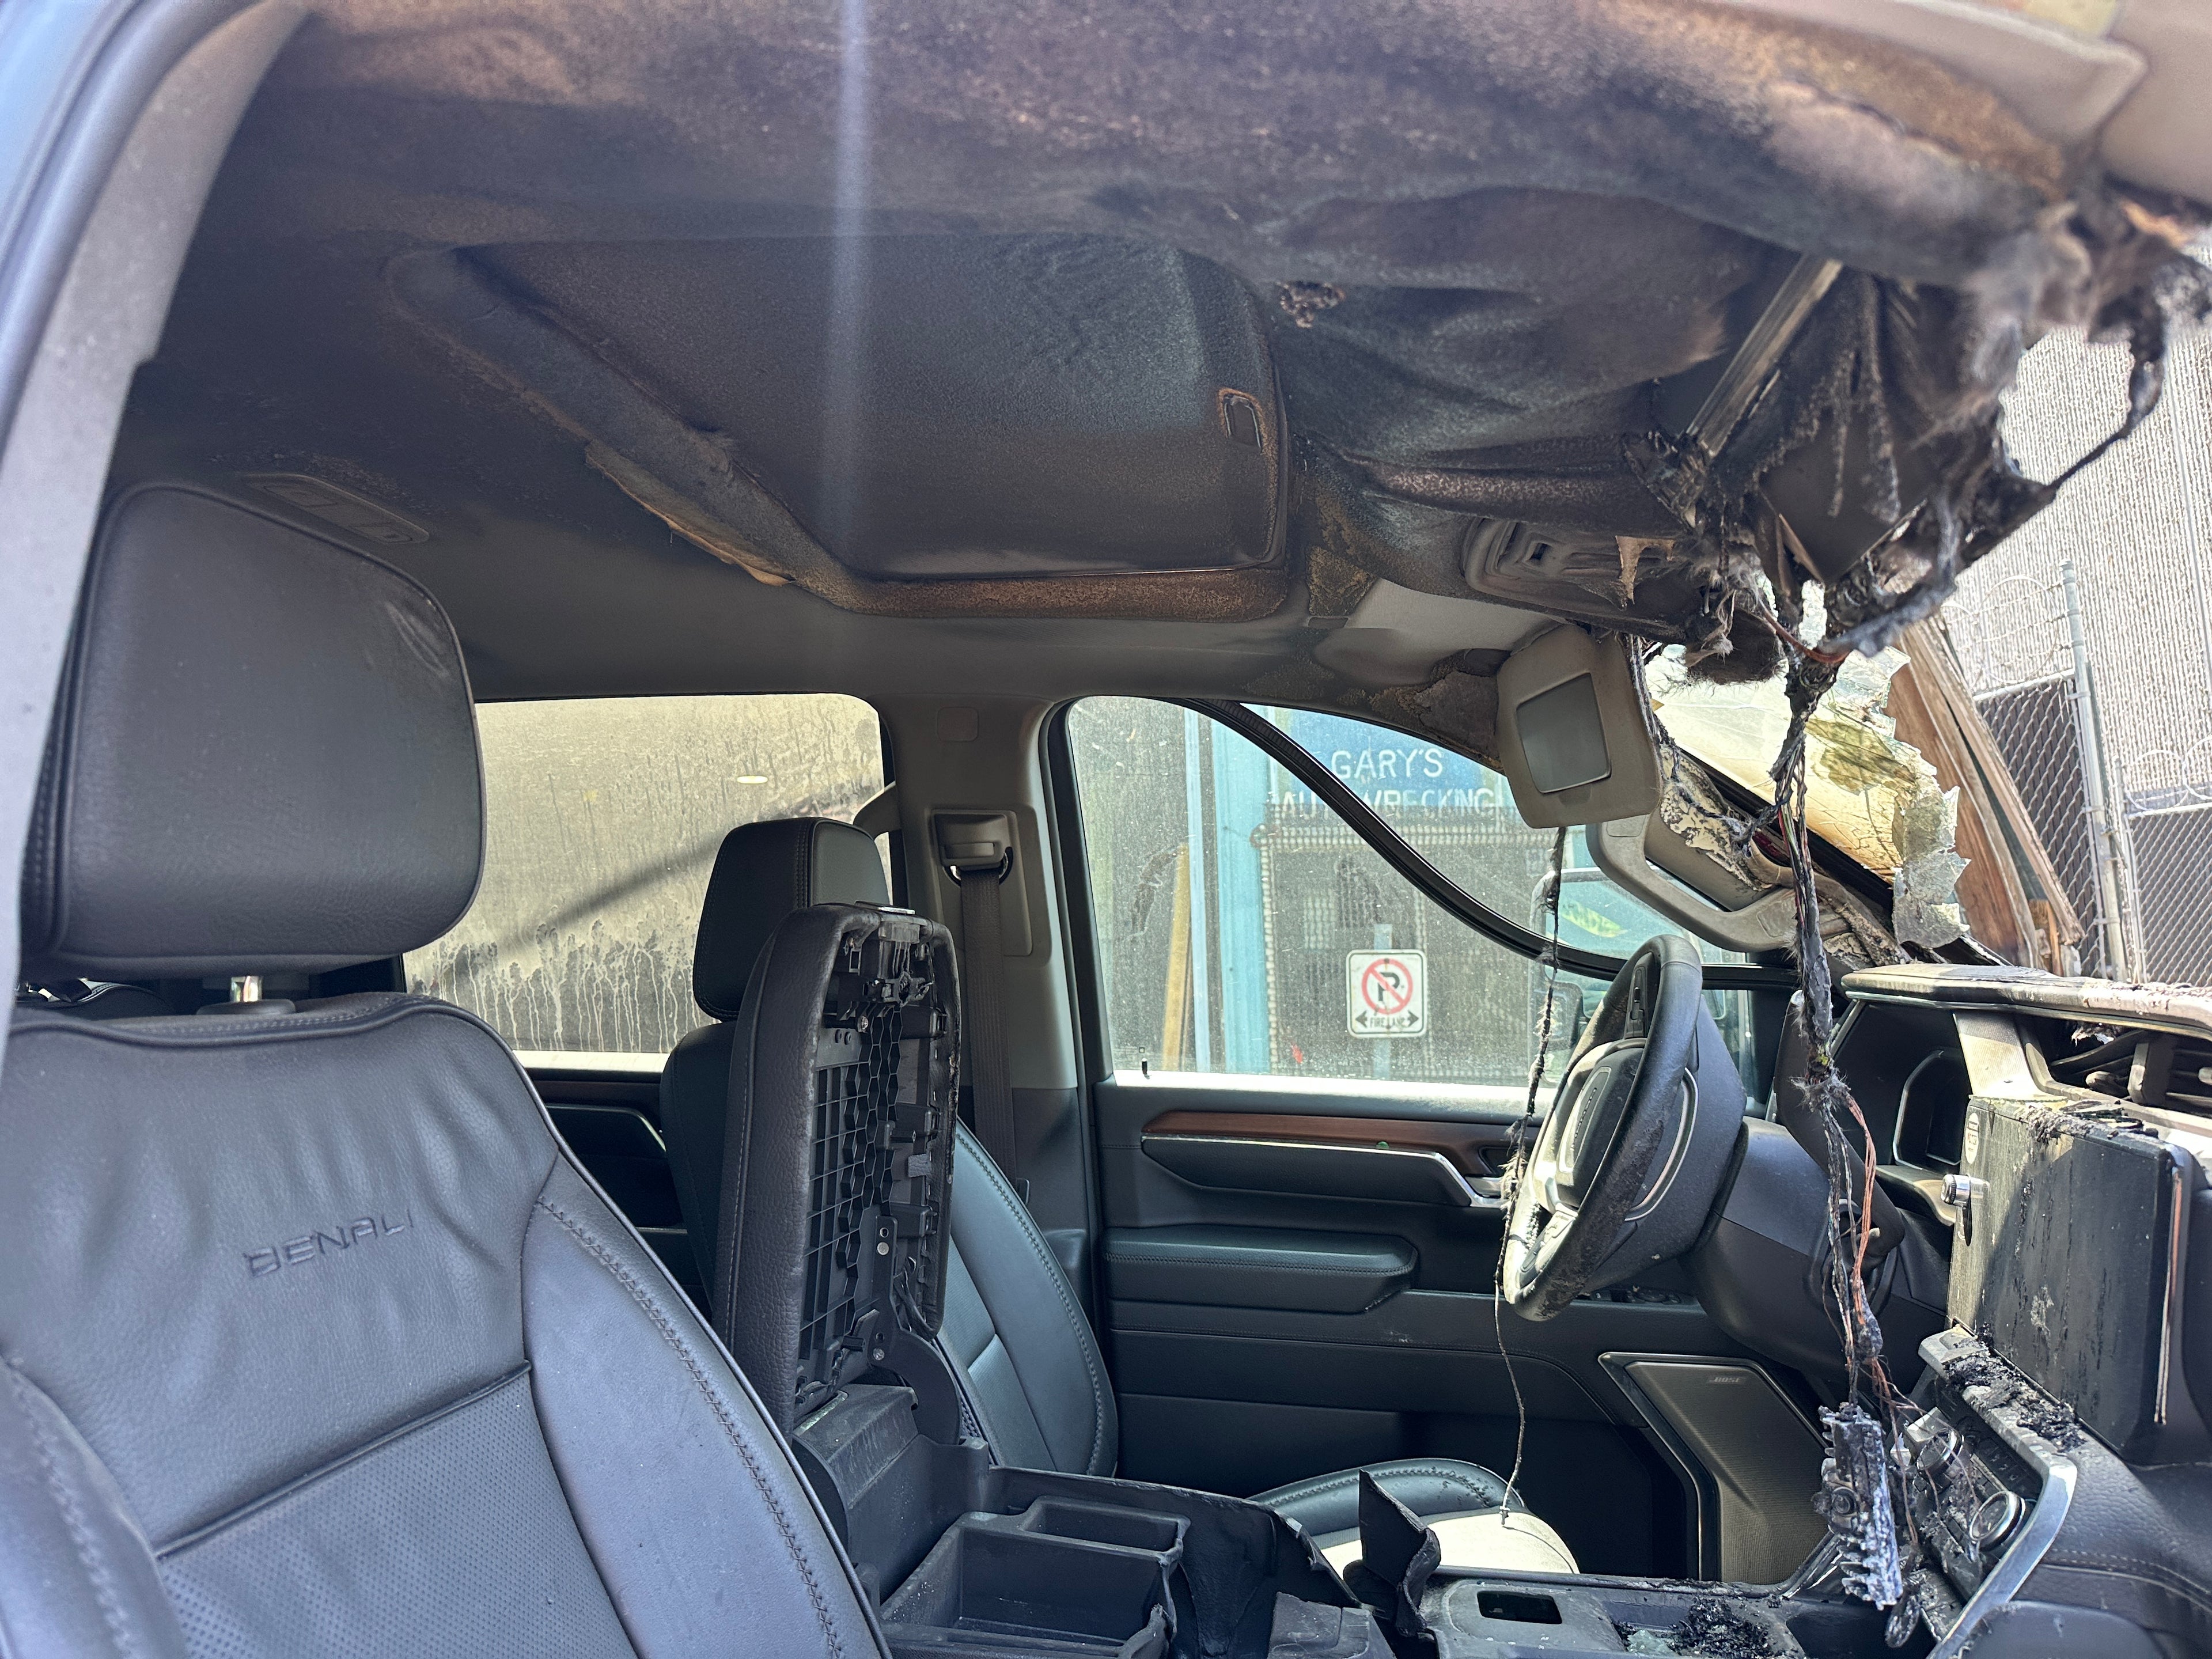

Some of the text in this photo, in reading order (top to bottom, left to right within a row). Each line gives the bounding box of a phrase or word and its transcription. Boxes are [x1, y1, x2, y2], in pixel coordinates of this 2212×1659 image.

[1331, 748, 1444, 779] GARY'S
[1282, 790, 1318, 819] AU
[243, 1209, 414, 1278] DENALI
